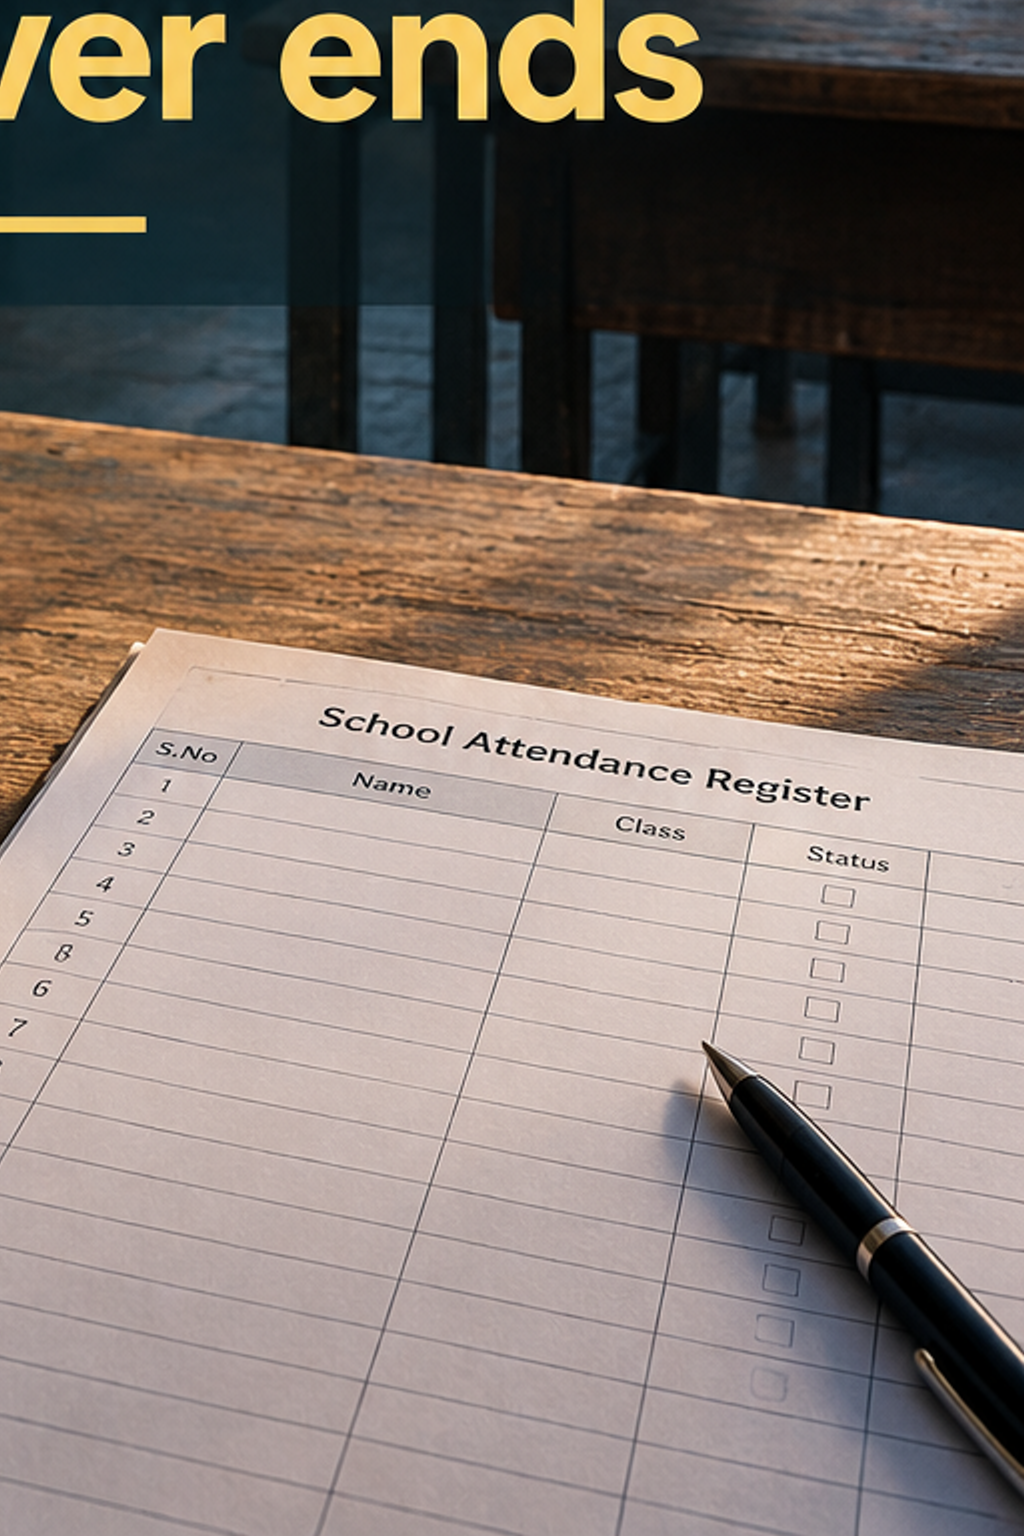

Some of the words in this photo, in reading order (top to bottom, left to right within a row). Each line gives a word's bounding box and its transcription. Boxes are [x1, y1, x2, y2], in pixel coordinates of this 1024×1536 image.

[155, 741, 218, 763] S.No
[318, 707, 455, 747] School
[462, 731, 692, 785] Attendance
[705, 768, 871, 812] Register
[161, 779, 172, 793] 1
[352, 771, 432, 799] Name
[136, 809, 155, 826] 2
[614, 815, 687, 842] Class
[117, 841, 136, 857] 3
[806, 845, 890, 875] Status
[95, 876, 114, 893] 4
[74, 909, 94, 927] 5
[32, 979, 52, 998] 6
[8, 1017, 28, 1038] 7
